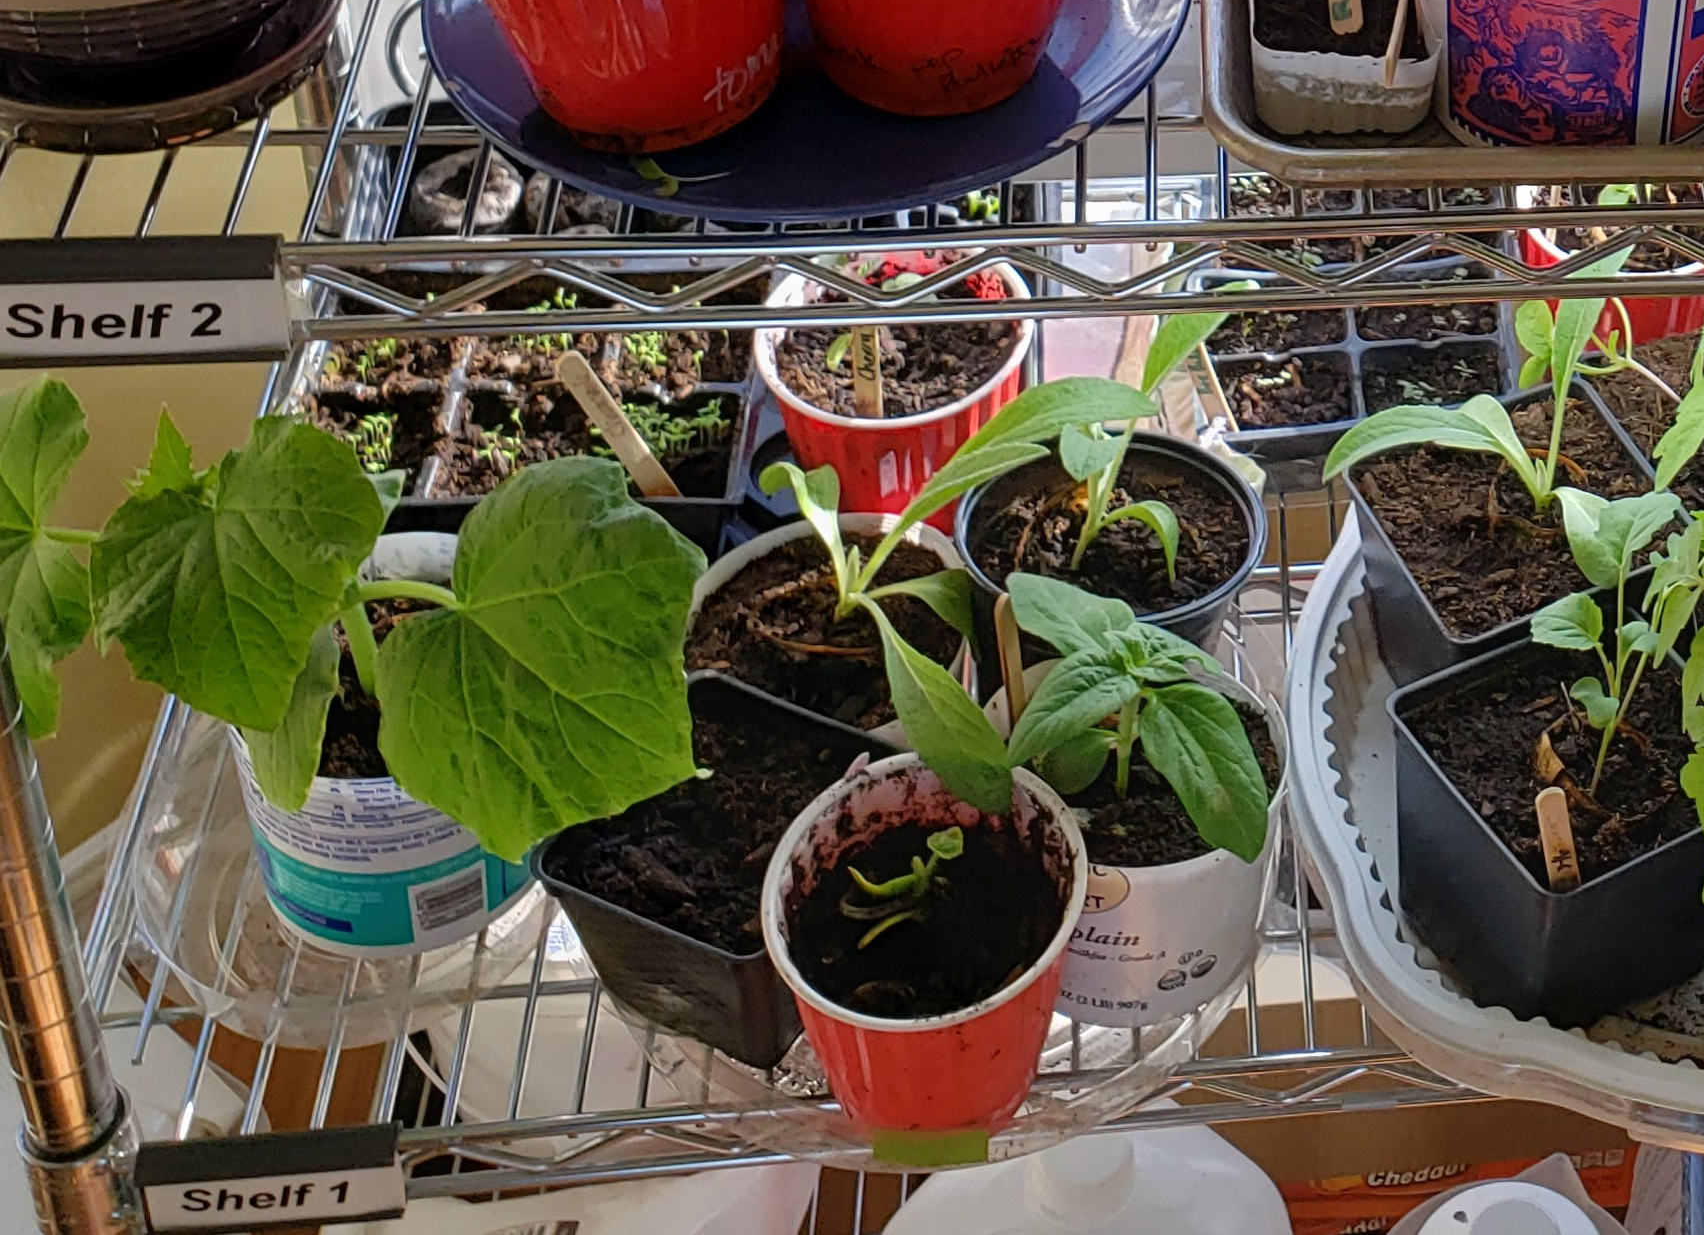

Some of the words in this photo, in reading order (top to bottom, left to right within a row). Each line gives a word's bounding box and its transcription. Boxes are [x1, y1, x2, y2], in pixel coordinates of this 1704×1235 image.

[6, 301, 174, 342] Shelf
[190, 301, 224, 338] 2
[1068, 927, 1140, 947] plain
[181, 1182, 315, 1212] Shelf
[328, 1181, 350, 1208] 1
